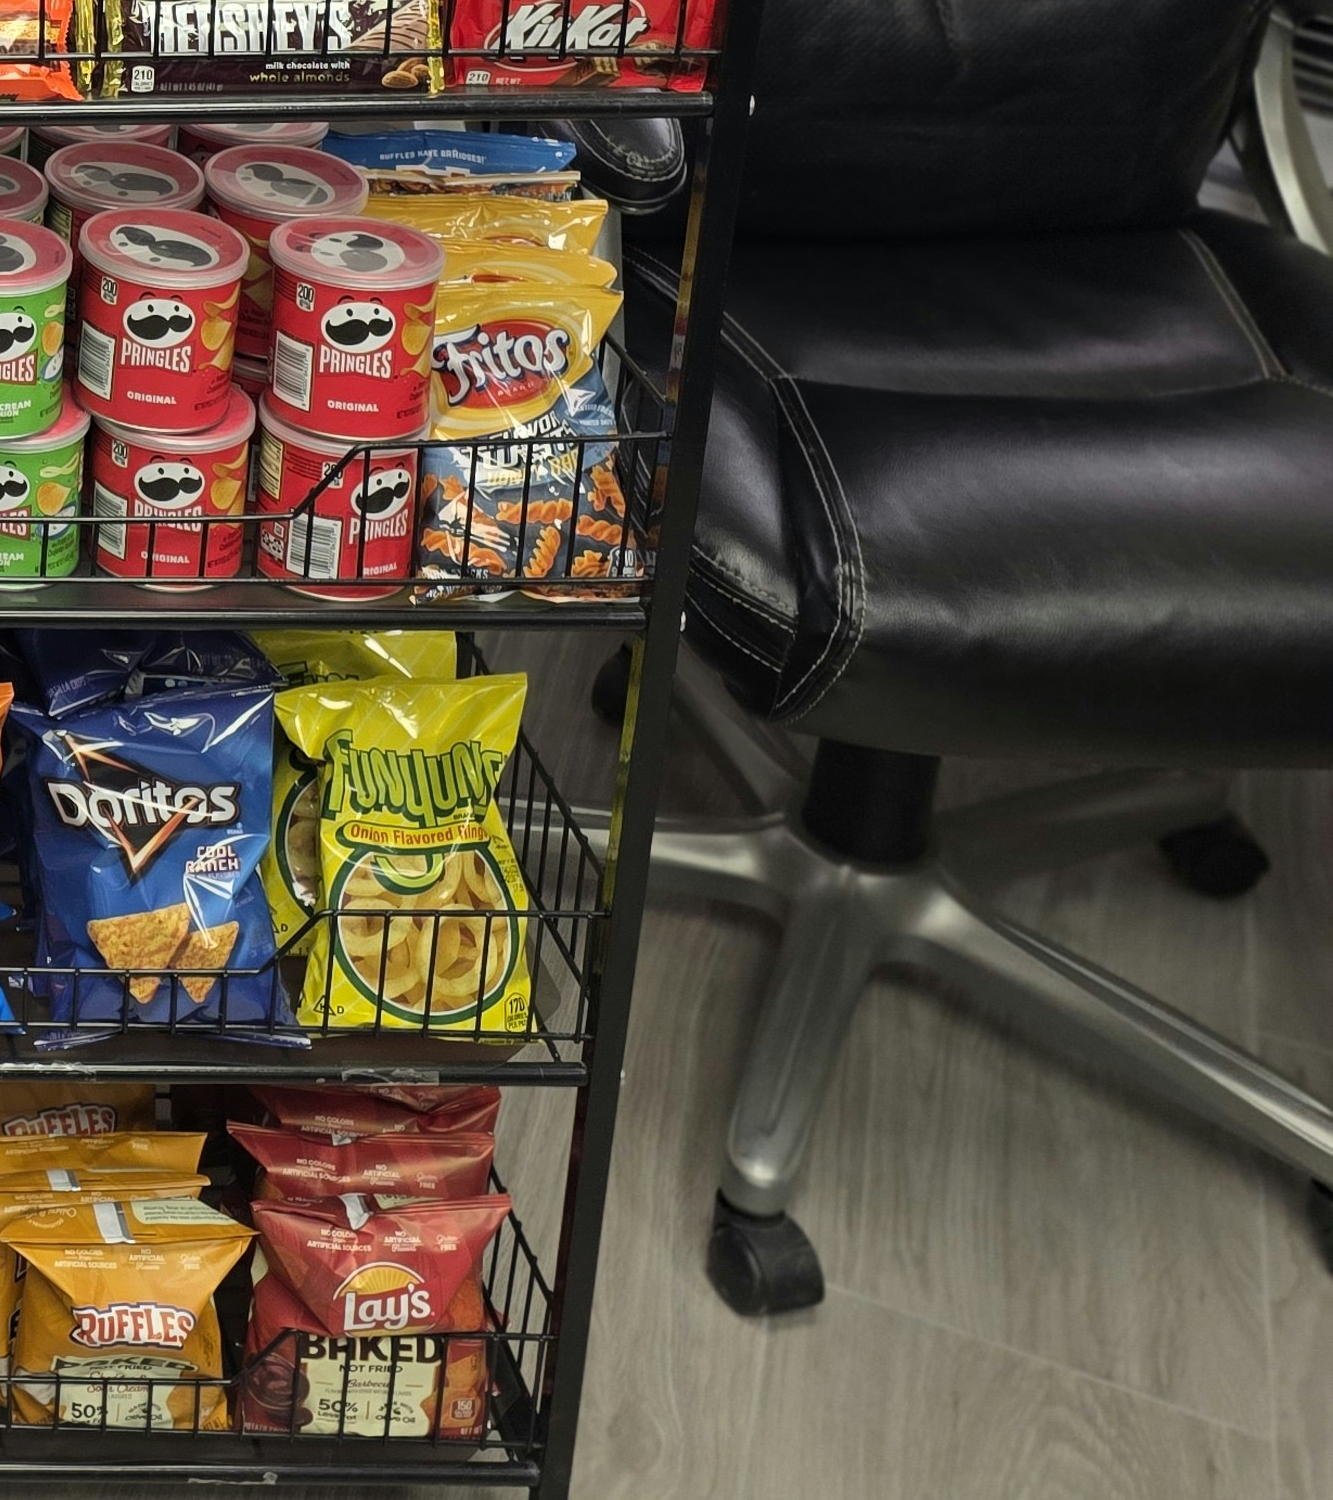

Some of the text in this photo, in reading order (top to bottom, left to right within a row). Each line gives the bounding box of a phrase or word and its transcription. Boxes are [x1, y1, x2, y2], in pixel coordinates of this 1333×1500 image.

[265, 61, 283, 70] milk
[286, 61, 329, 70] chocolate
[134, 69, 153, 81] 210
[250, 71, 350, 83] whole almonds
[468, 72, 489, 82] 210
[102, 277, 117, 295] 200
[298, 285, 314, 302] 200
[121, 339, 192, 373] PRINGLES
[320, 346, 392, 379] PRINGLES
[433, 325, 569, 407] Fritos
[127, 391, 176, 404] ORIGINAL
[327, 401, 379, 412] ORIGINAL
[47, 779, 236, 827] Doritos
[350, 825, 453, 845] Onion Flavored
[197, 846, 237, 857] COOL
[186, 858, 240, 873] RANCH
[509, 997, 525, 1014] 170
[364, 1169, 400, 1178] ARTIFICIAL
[129, 1254, 165, 1262] ARTIFICIAL
[344, 1283, 430, 1330] Lay's
[75, 1307, 193, 1346] RUFFLES
[301, 1334, 442, 1362] BAKED
[457, 1400, 472, 1410] 150
